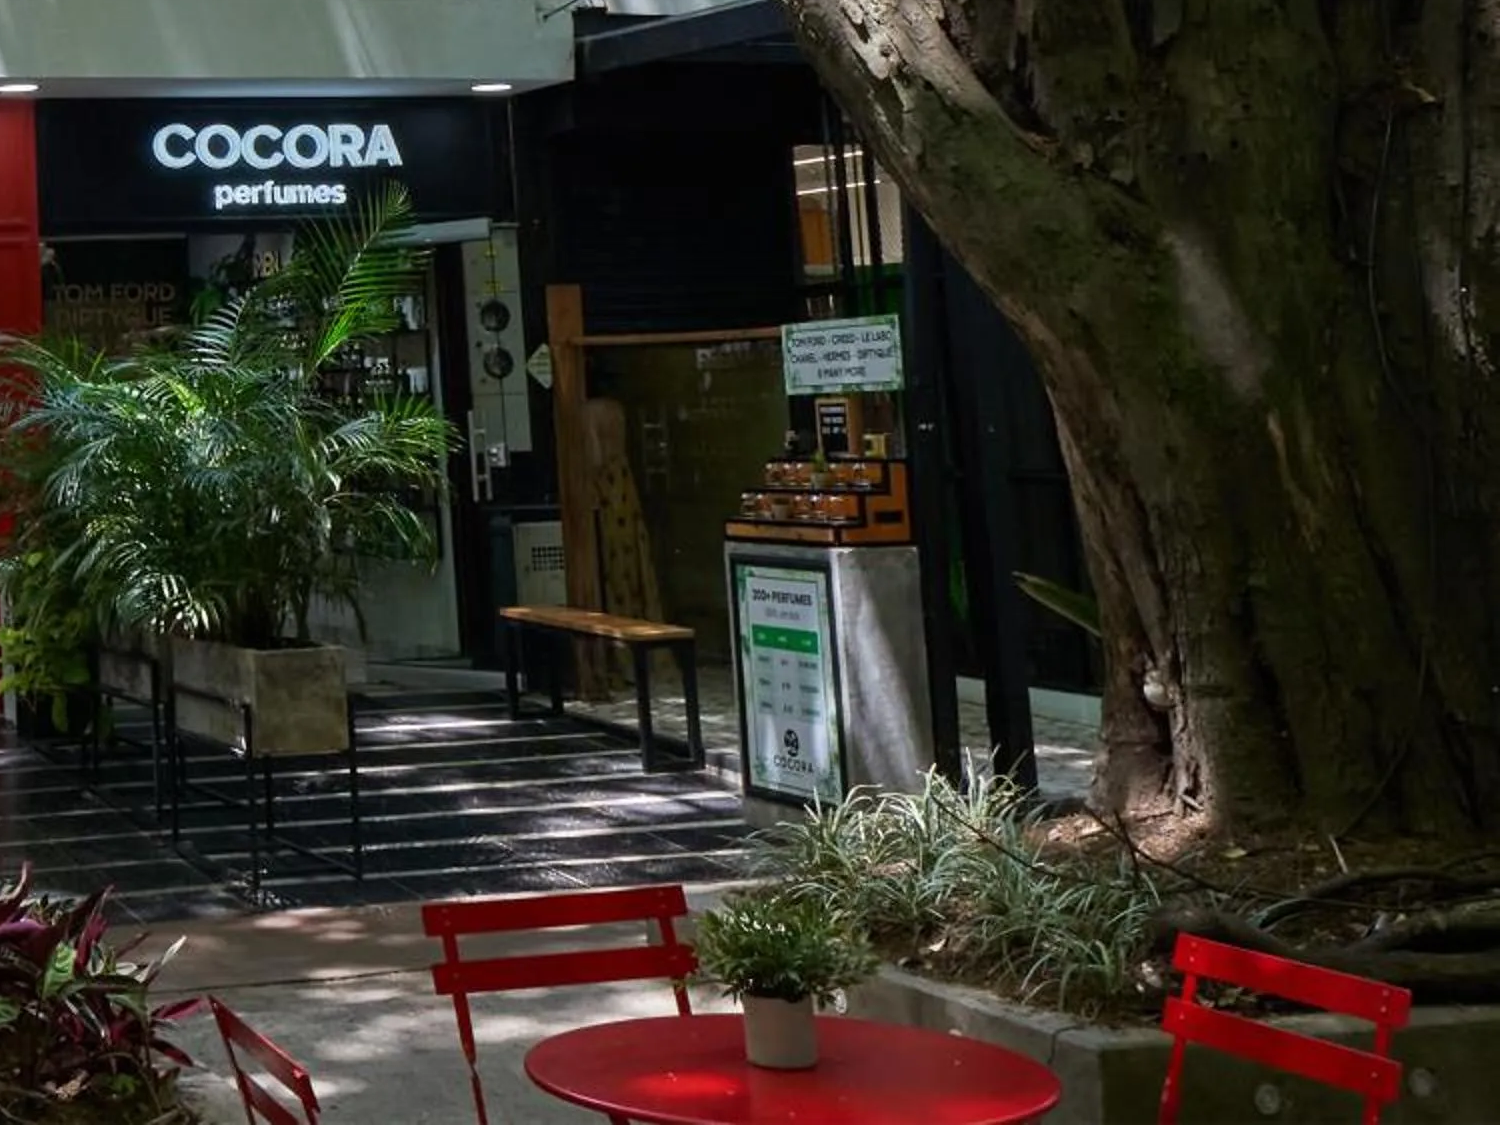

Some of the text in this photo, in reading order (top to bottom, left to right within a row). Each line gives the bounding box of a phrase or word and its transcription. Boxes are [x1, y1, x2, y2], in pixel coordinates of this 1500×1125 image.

[152, 123, 403, 169] COCORA
[213, 180, 348, 209] perfumes
[52, 281, 176, 303] TOM FORD
[771, 590, 813, 607] PERFUMES
[773, 755, 814, 774] COCORA
